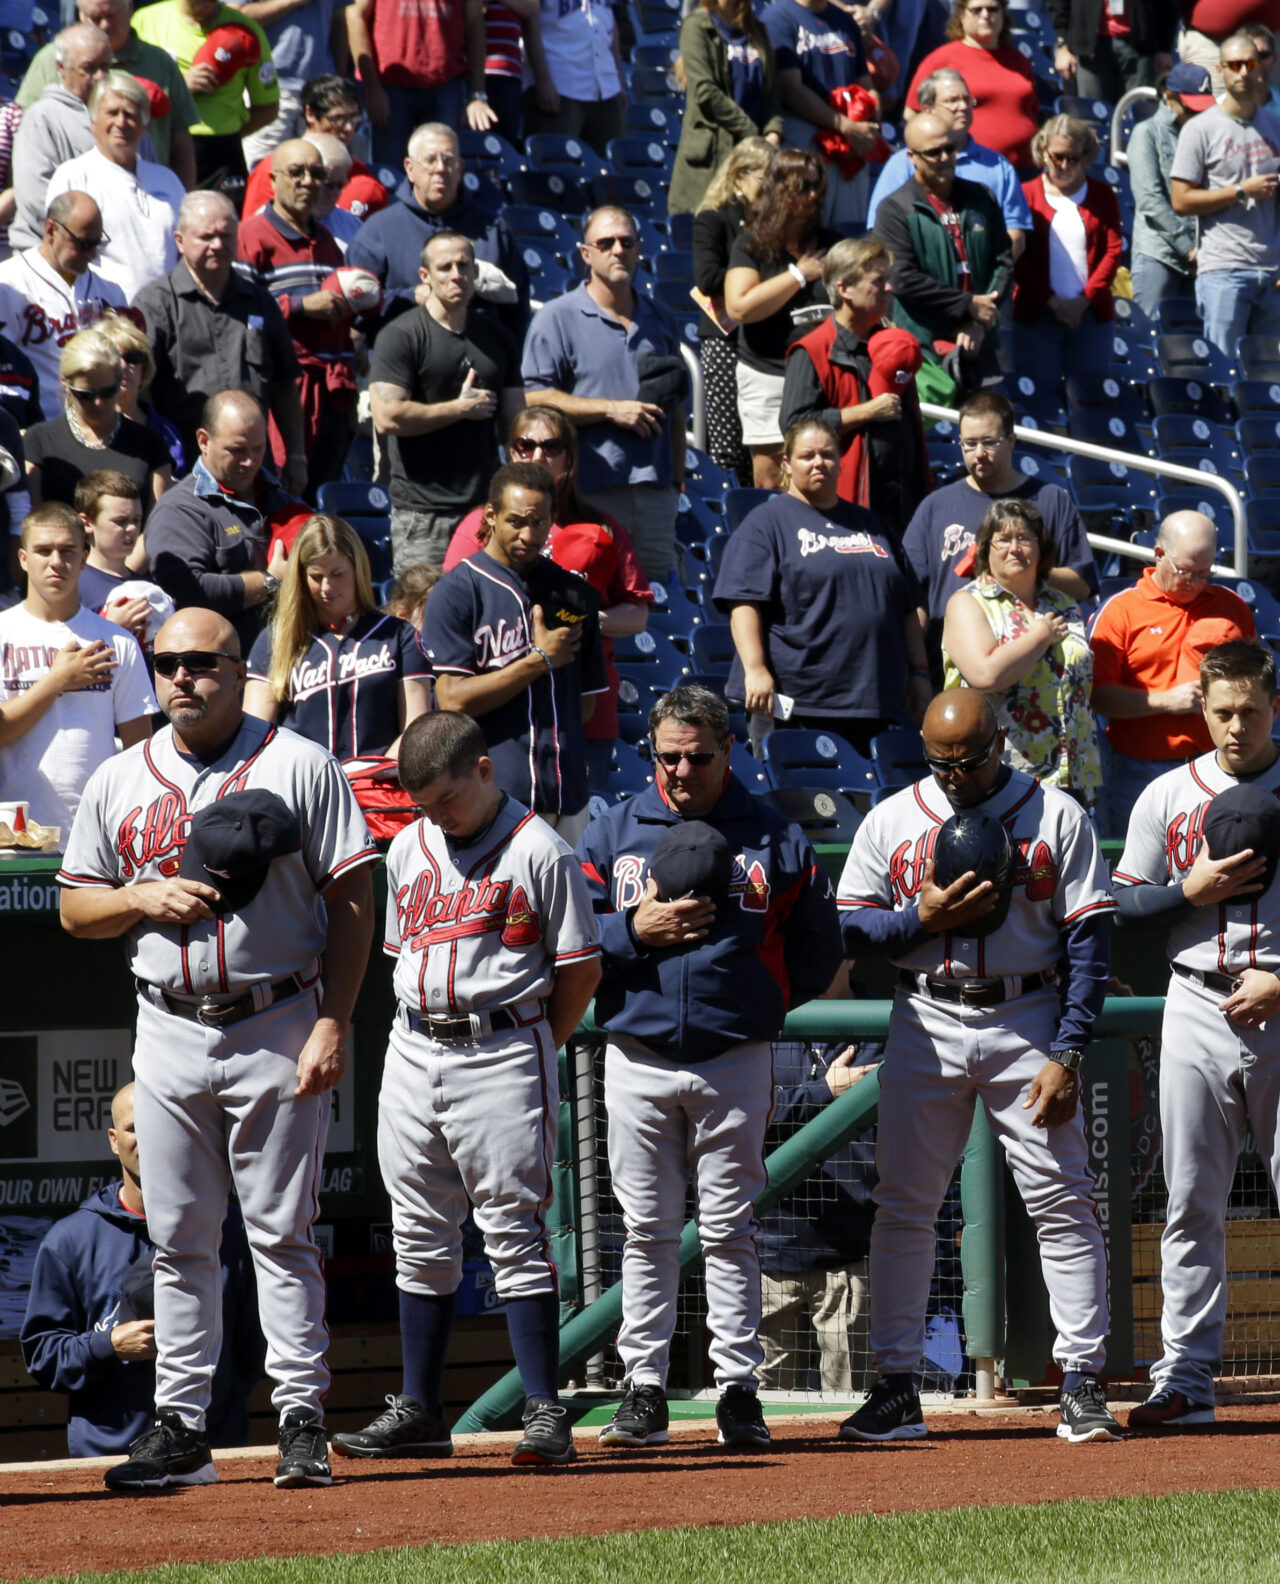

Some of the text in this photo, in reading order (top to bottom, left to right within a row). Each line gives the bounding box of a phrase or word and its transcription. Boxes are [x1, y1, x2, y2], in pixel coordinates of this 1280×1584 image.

[473, 617, 525, 668] Nat
[289, 645, 396, 696] Nat Pack
[118, 791, 194, 877] Atla
[396, 869, 511, 942] Atlanta
[53, 1058, 117, 1094] NEW
[38, 1178, 83, 1204] OWN
[321, 1167, 353, 1193] LAG
